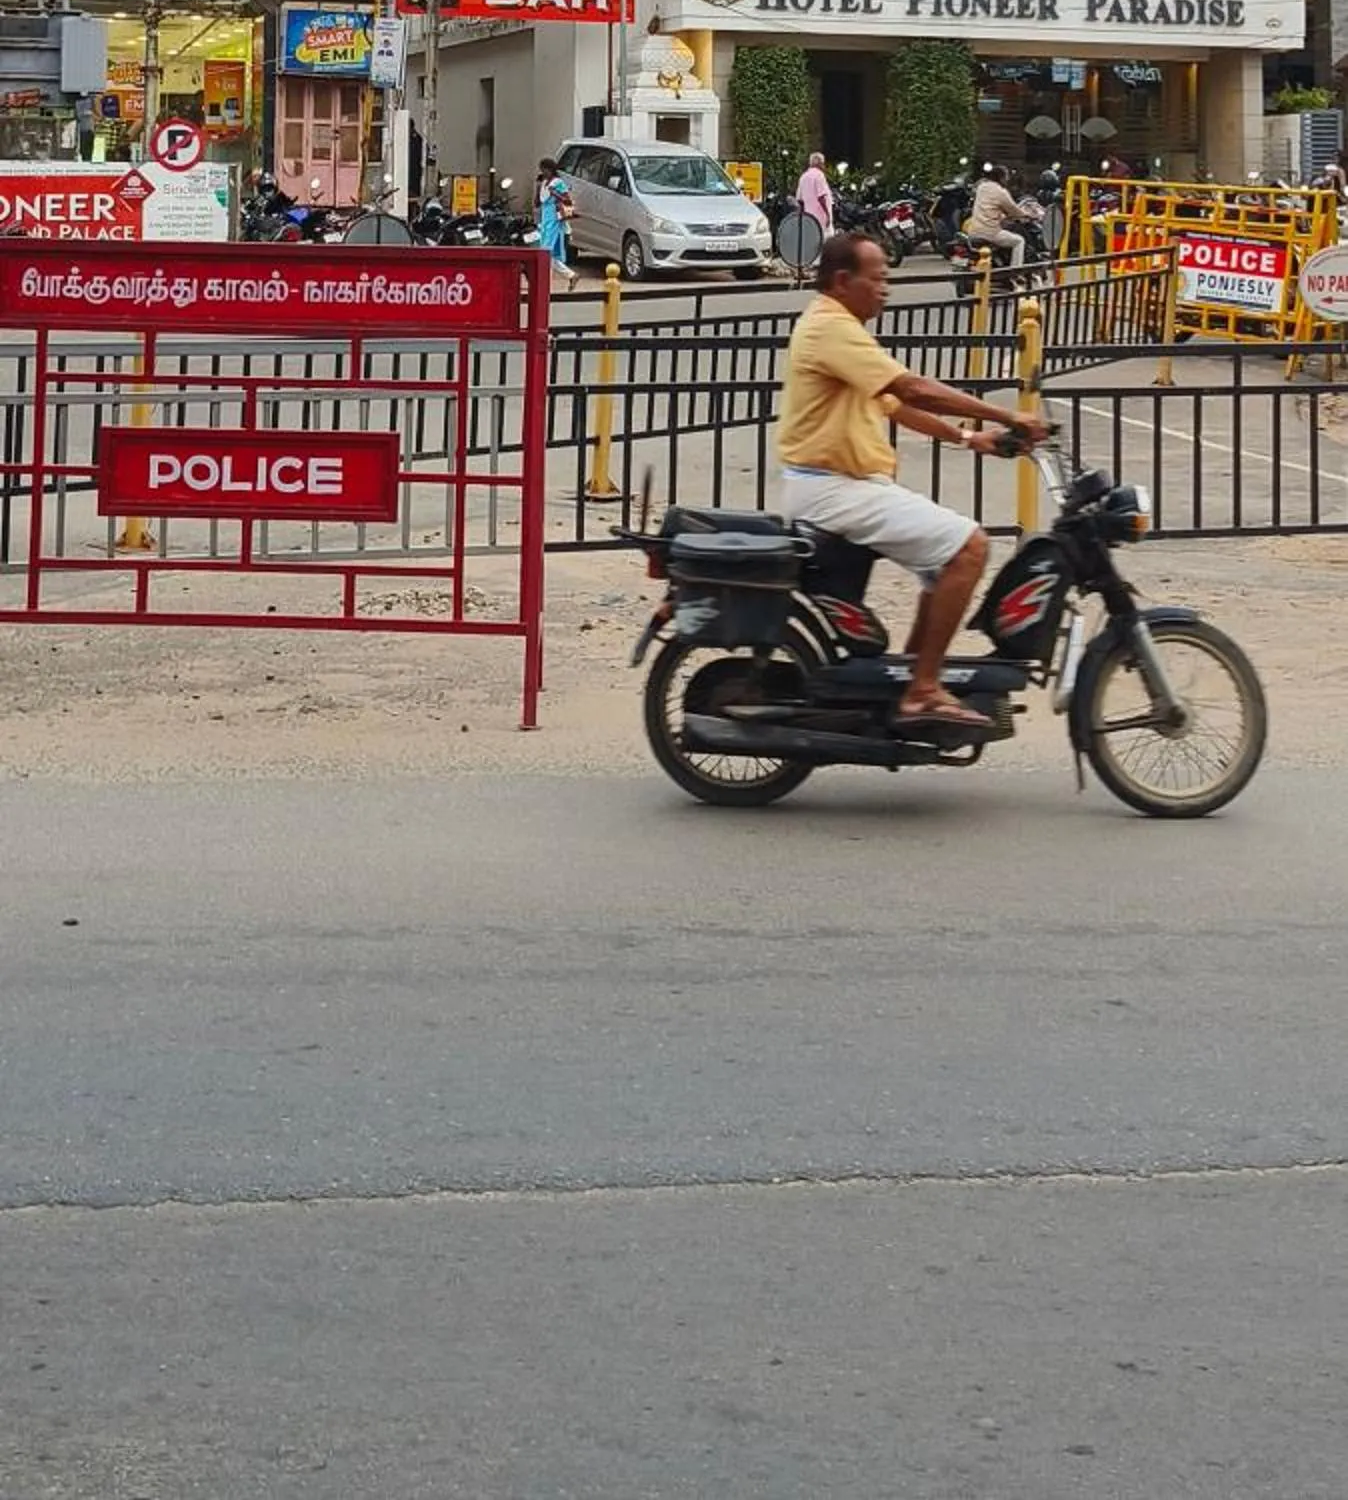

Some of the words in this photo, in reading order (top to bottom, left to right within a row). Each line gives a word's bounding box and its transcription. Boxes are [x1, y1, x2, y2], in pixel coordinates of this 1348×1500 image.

[306, 29, 354, 47] SMART
[319, 47, 355, 62] EMI
[59, 223, 137, 240] PALACE
[1178, 242, 1278, 274] POLICE
[20, 265, 199, 308] போக்குவரத்து
[1196, 272, 1275, 296] PONJESLY
[1307, 275, 1325, 293] NO
[148, 453, 345, 495] POLICE
